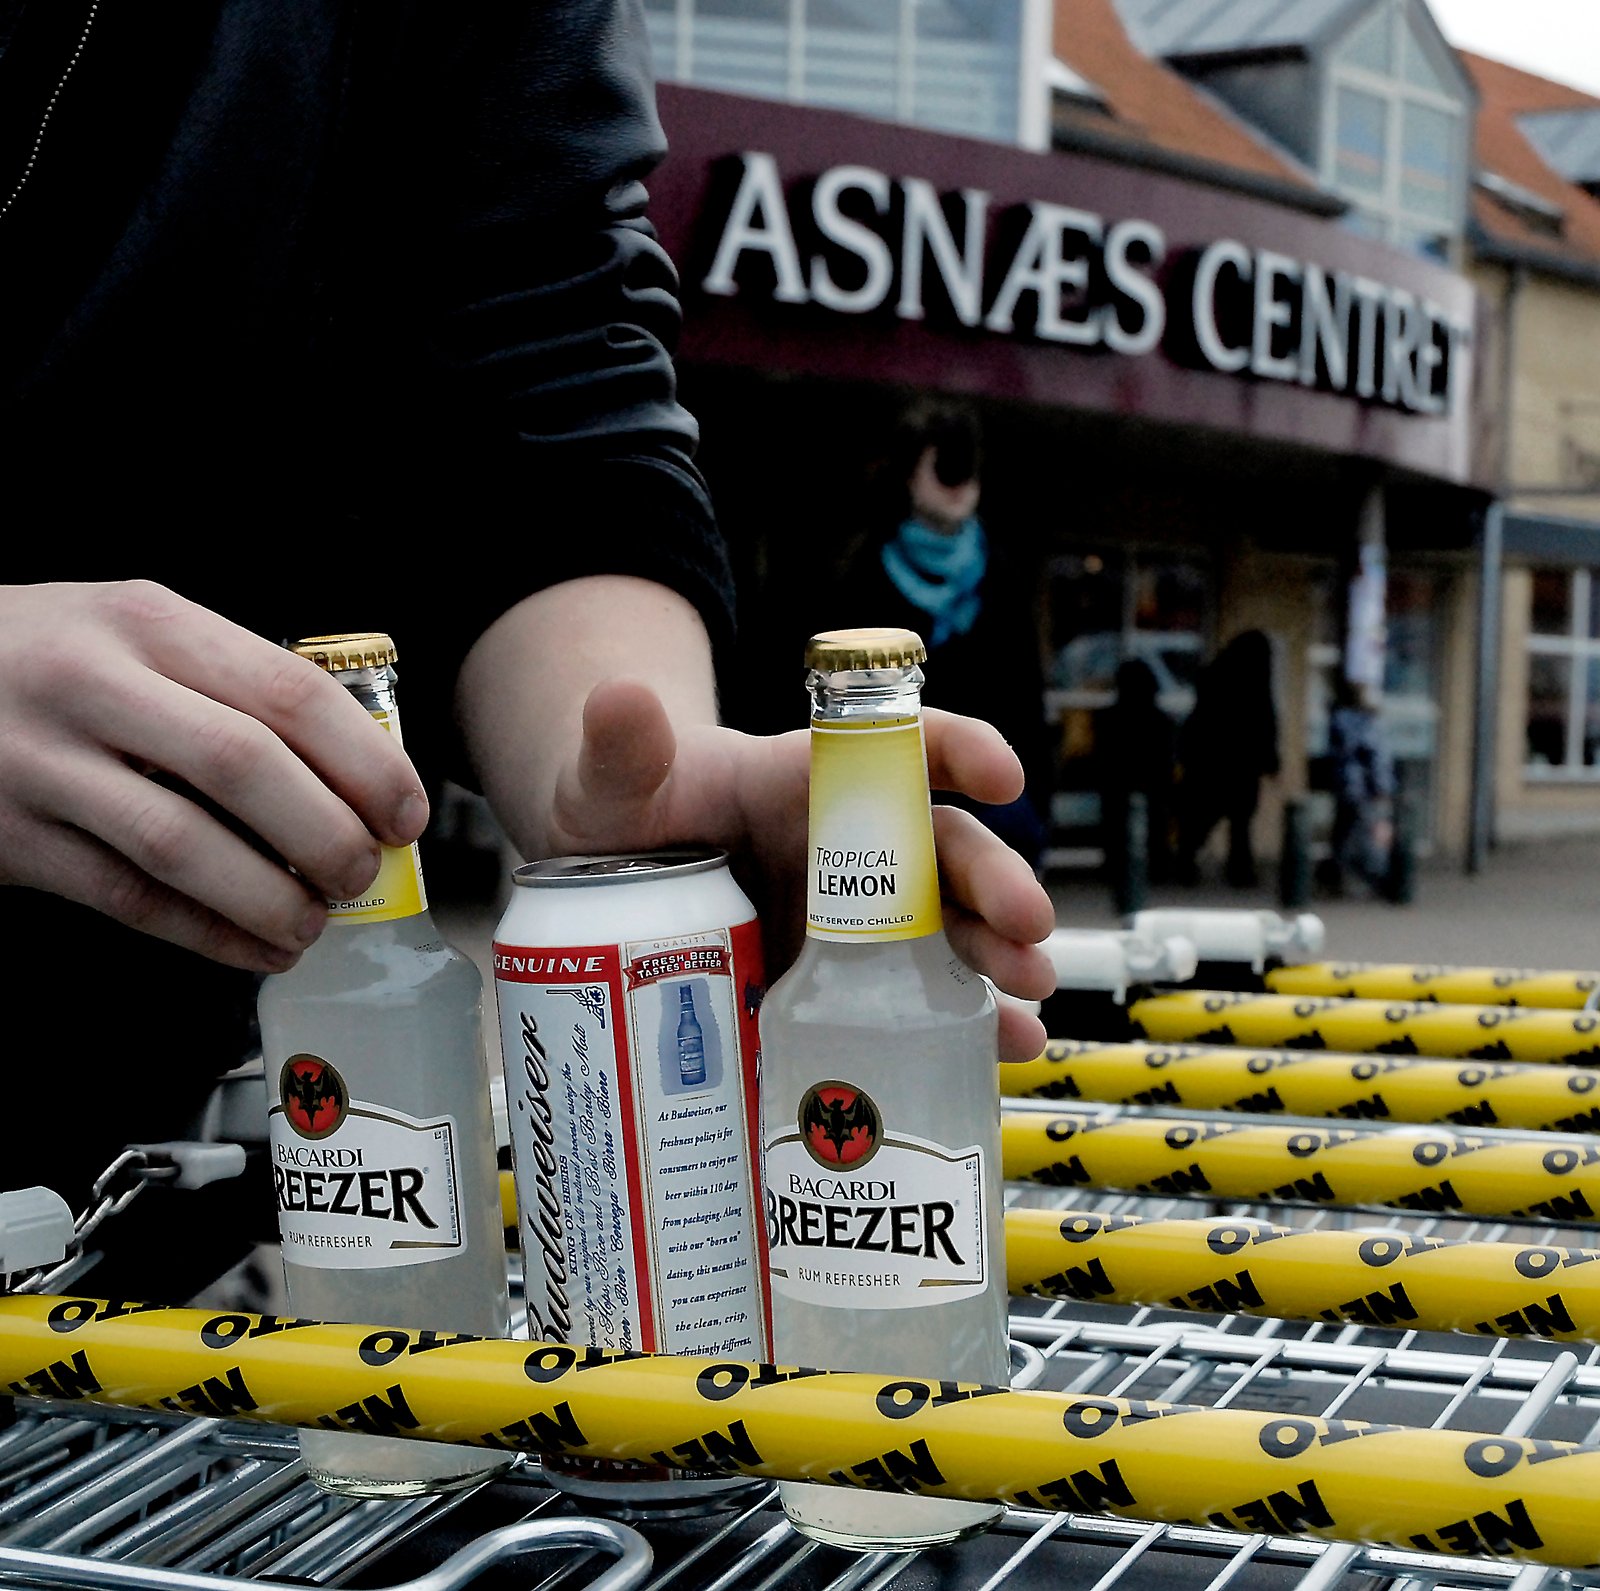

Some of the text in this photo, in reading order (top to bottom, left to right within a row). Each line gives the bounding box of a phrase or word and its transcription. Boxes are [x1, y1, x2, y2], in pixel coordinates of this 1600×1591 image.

[702, 150, 1166, 357] ASNÆS
[816, 846, 899, 869] TROPICAL
[818, 869, 897, 897] LEMON
[340, 897, 386, 911] CHILLED
[809, 912, 915, 926] BEST SERVED CHILLED
[653, 935, 708, 949] QUALITY
[493, 953, 606, 974] GENUINE
[636, 959, 722, 979] TASTES BETTER
[642, 951, 720, 970] FRESH BEER
[570, 1022, 591, 1077] Malt
[577, 1080, 597, 1145] Barley
[671, 1106, 714, 1121] Budweiser,
[694, 1131, 717, 1147] policy
[277, 1143, 364, 1168] BACARDI
[602, 1129, 618, 1180] Birra
[582, 1149, 601, 1197] Best
[659, 1162, 699, 1175] consumers
[700, 1159, 708, 1169] to
[274, 1163, 440, 1230] REEZER
[665, 1190, 682, 1201] beer
[683, 1185, 708, 1199] within
[709, 1182, 723, 1194] 110
[788, 1173, 897, 1201] BACARDI
[559, 1154, 579, 1277] KING OF BEERS
[589, 1201, 604, 1231] and
[609, 1190, 625, 1252] Cerveza
[661, 1216, 682, 1231] from
[767, 1187, 966, 1266] BREEZER
[288, 1230, 373, 1248] RUM REFRESHER
[668, 1241, 688, 1253] with
[689, 1240, 704, 1251] our
[591, 1234, 610, 1281] Rice
[666, 1267, 695, 1282] dating,
[696, 1264, 711, 1277] this
[711, 1261, 734, 1274] means
[799, 1267, 902, 1287] RUM REFRESHER
[614, 1265, 630, 1307] Bier
[671, 1284, 748, 1309] you can experience
[583, 1313, 597, 1347] rewed
[675, 1311, 749, 1333] the clean, crisp,
